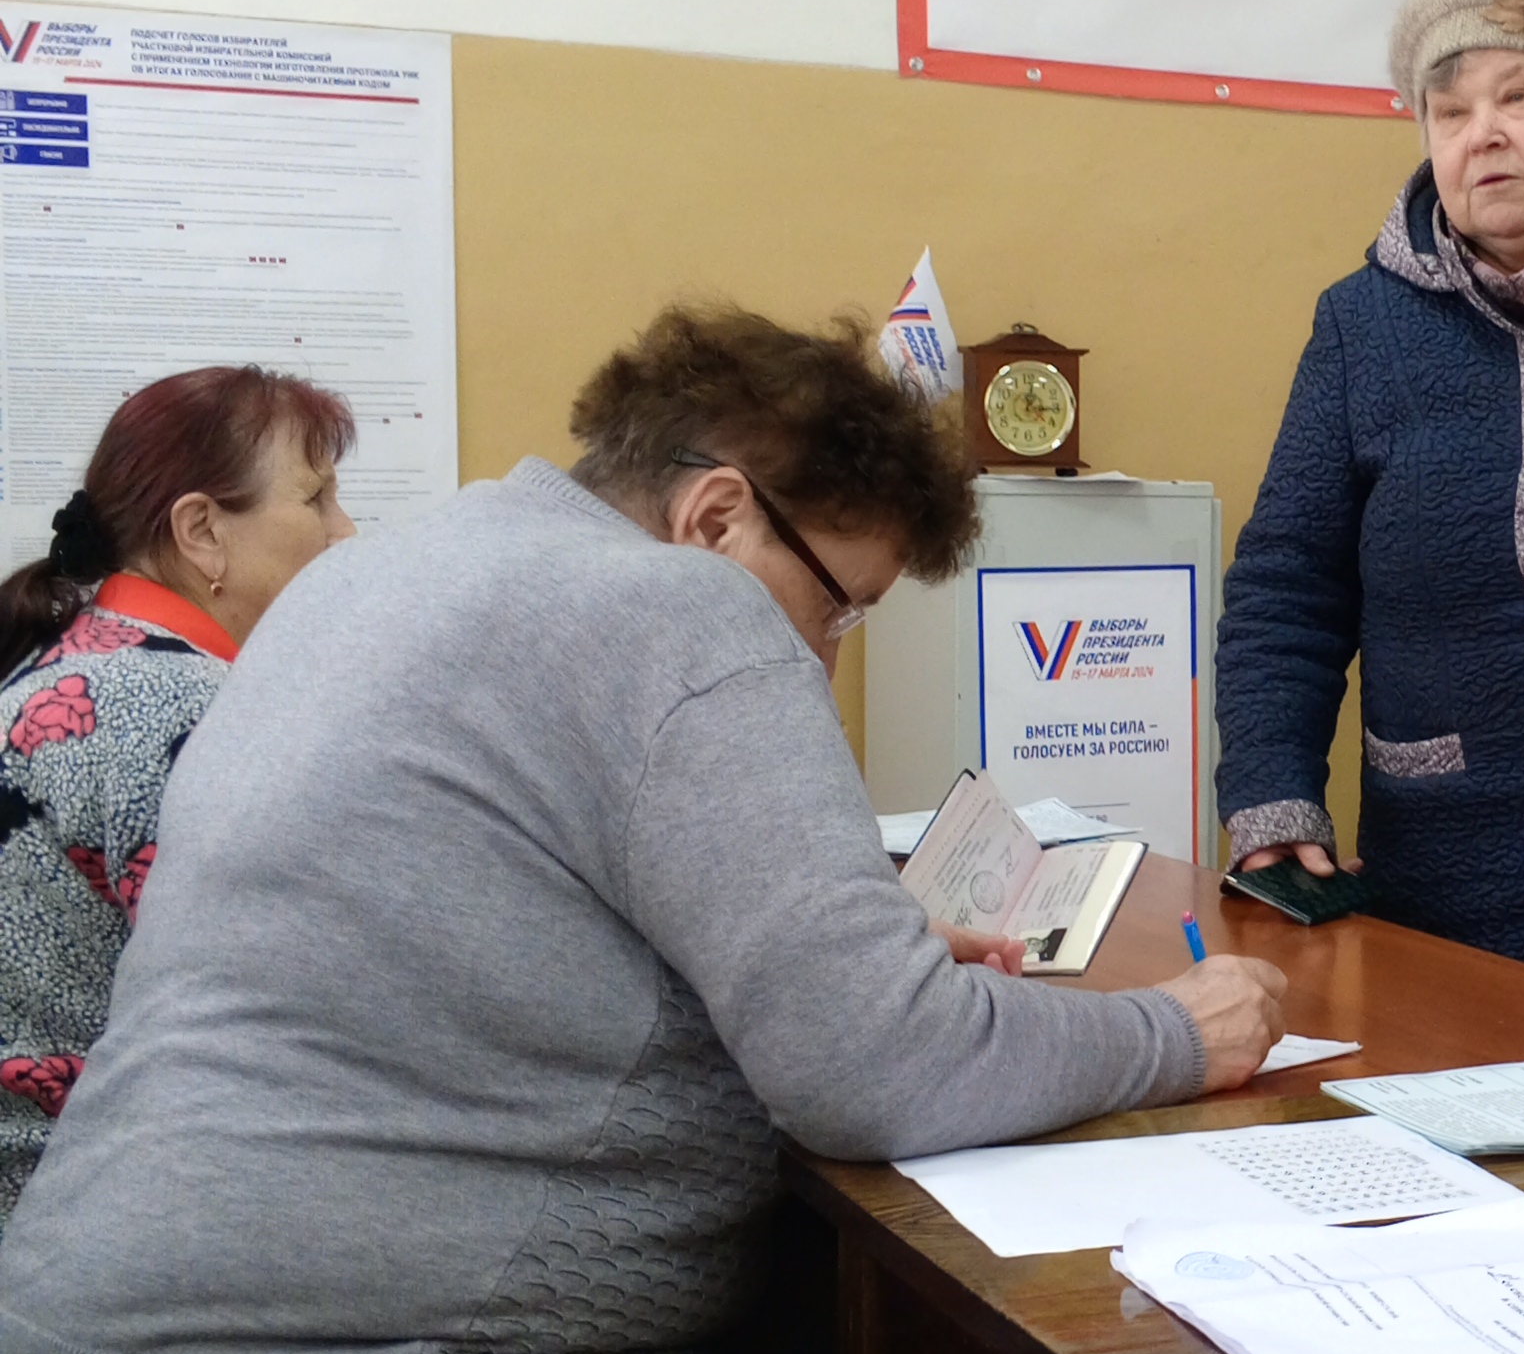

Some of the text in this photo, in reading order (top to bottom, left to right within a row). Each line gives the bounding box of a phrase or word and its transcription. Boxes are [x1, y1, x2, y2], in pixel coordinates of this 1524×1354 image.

[1089, 618, 1148, 632] ВЫБОРЫ
[1082, 634, 1165, 649] ПРЕЗИДЕНТА
[1076, 652, 1130, 665] РОССИИ
[1099, 667, 1130, 678] МАРТА
[1025, 723, 1078, 739] ВМЕСТЕ
[1083, 722, 1106, 736] МЫ
[1110, 720, 1145, 735] СИЛА
[1013, 738, 1169, 760] ГОЛОСУЕМ ЗА РОССИЮ!
